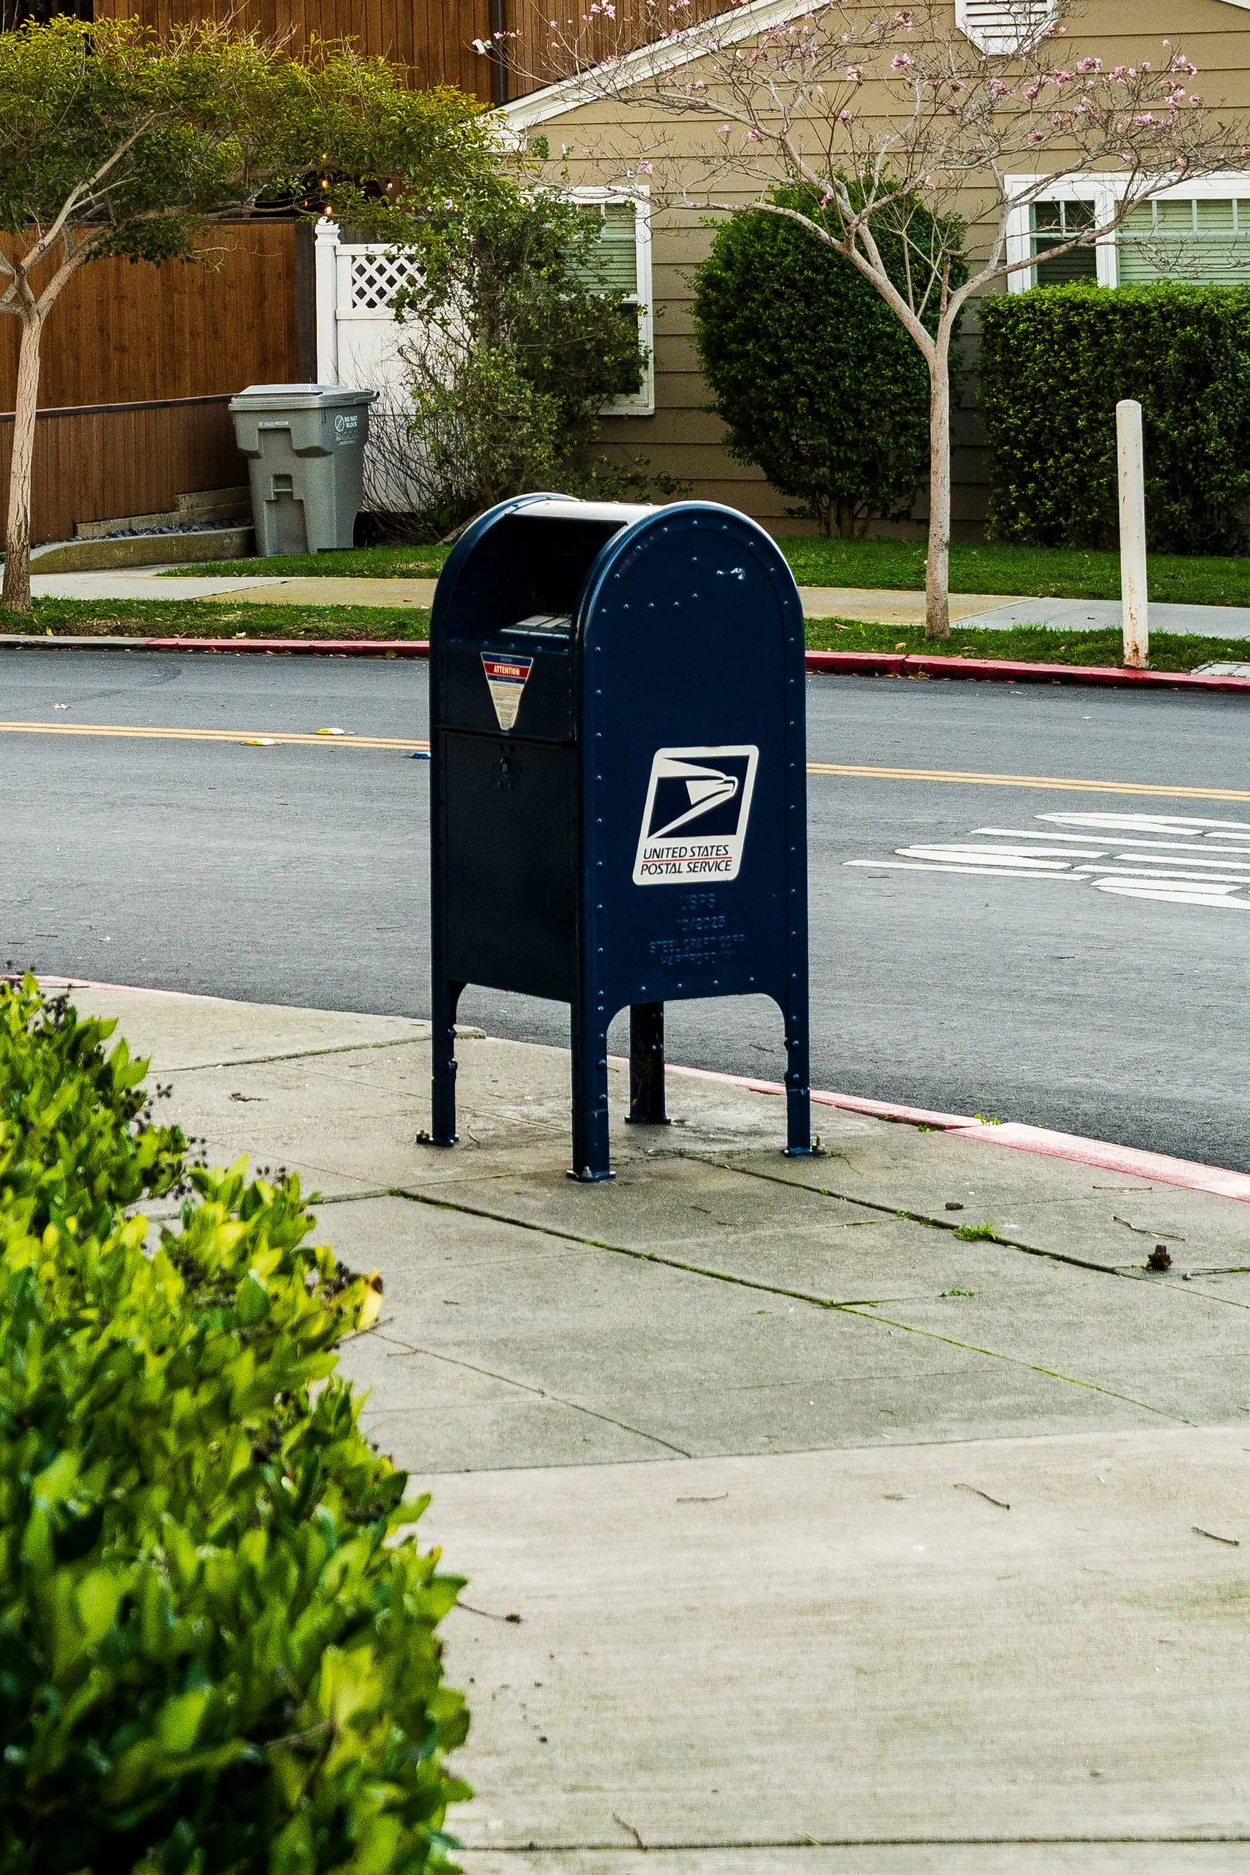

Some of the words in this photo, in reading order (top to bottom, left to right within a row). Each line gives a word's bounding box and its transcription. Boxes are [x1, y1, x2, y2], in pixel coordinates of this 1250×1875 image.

[493, 664, 520, 676] ATTENTION
[643, 847, 687, 859] UNITED
[689, 844, 729, 858] STATES
[640, 863, 683, 875] POSTAL
[686, 860, 731, 873] SERVICE
[679, 893, 716, 910] USPS
